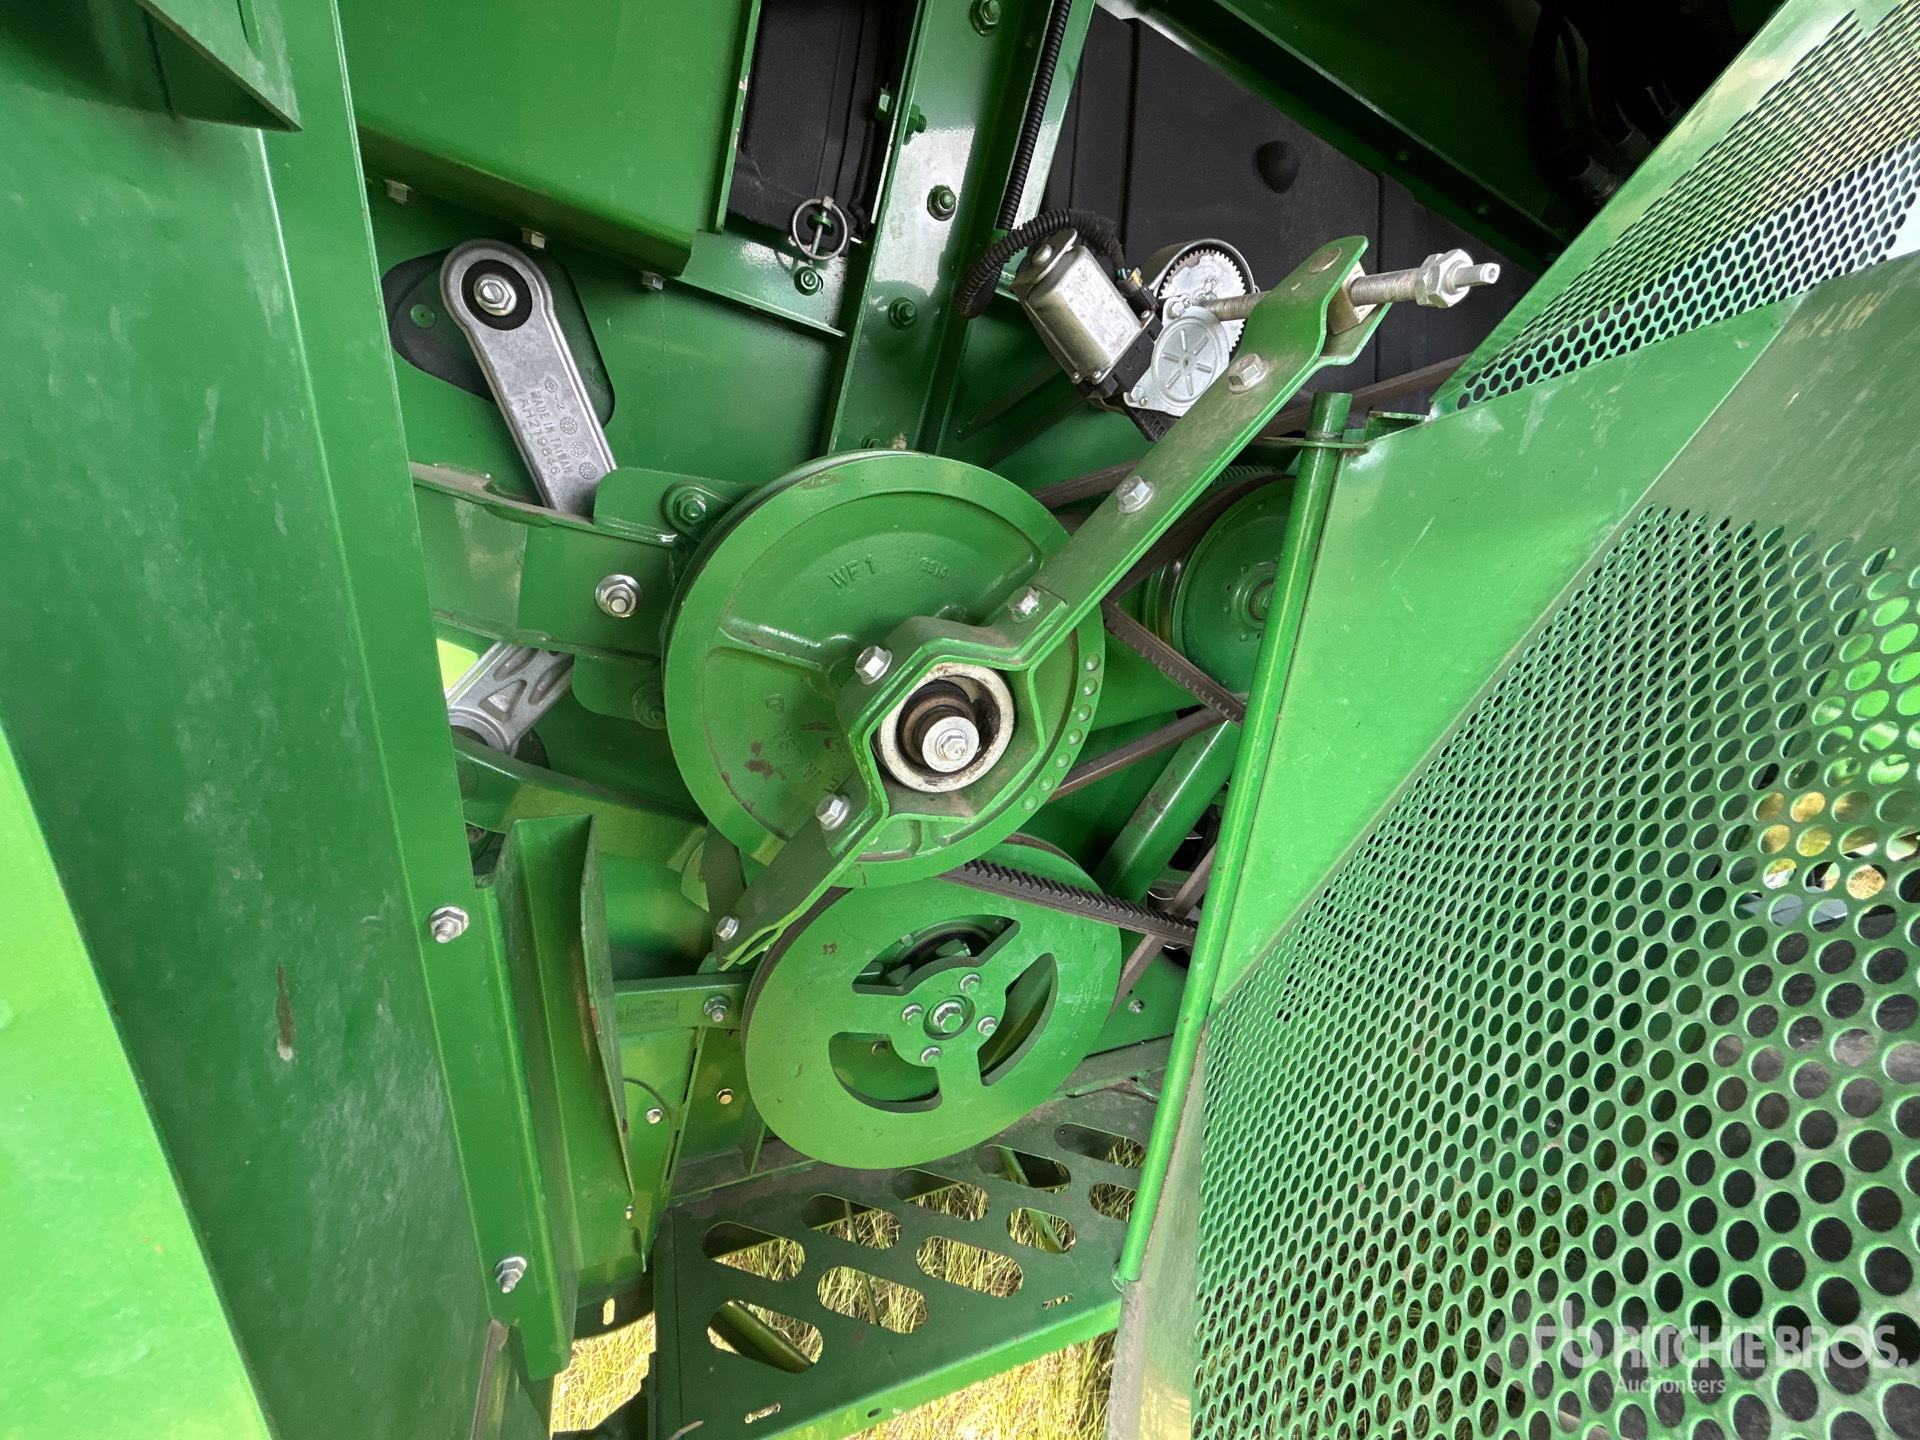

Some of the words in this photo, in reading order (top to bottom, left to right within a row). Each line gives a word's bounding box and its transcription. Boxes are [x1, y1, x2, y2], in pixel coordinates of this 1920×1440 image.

[530, 390, 551, 420] MADE
[543, 421, 557, 433] IN
[549, 437, 575, 474] TAIWAN
